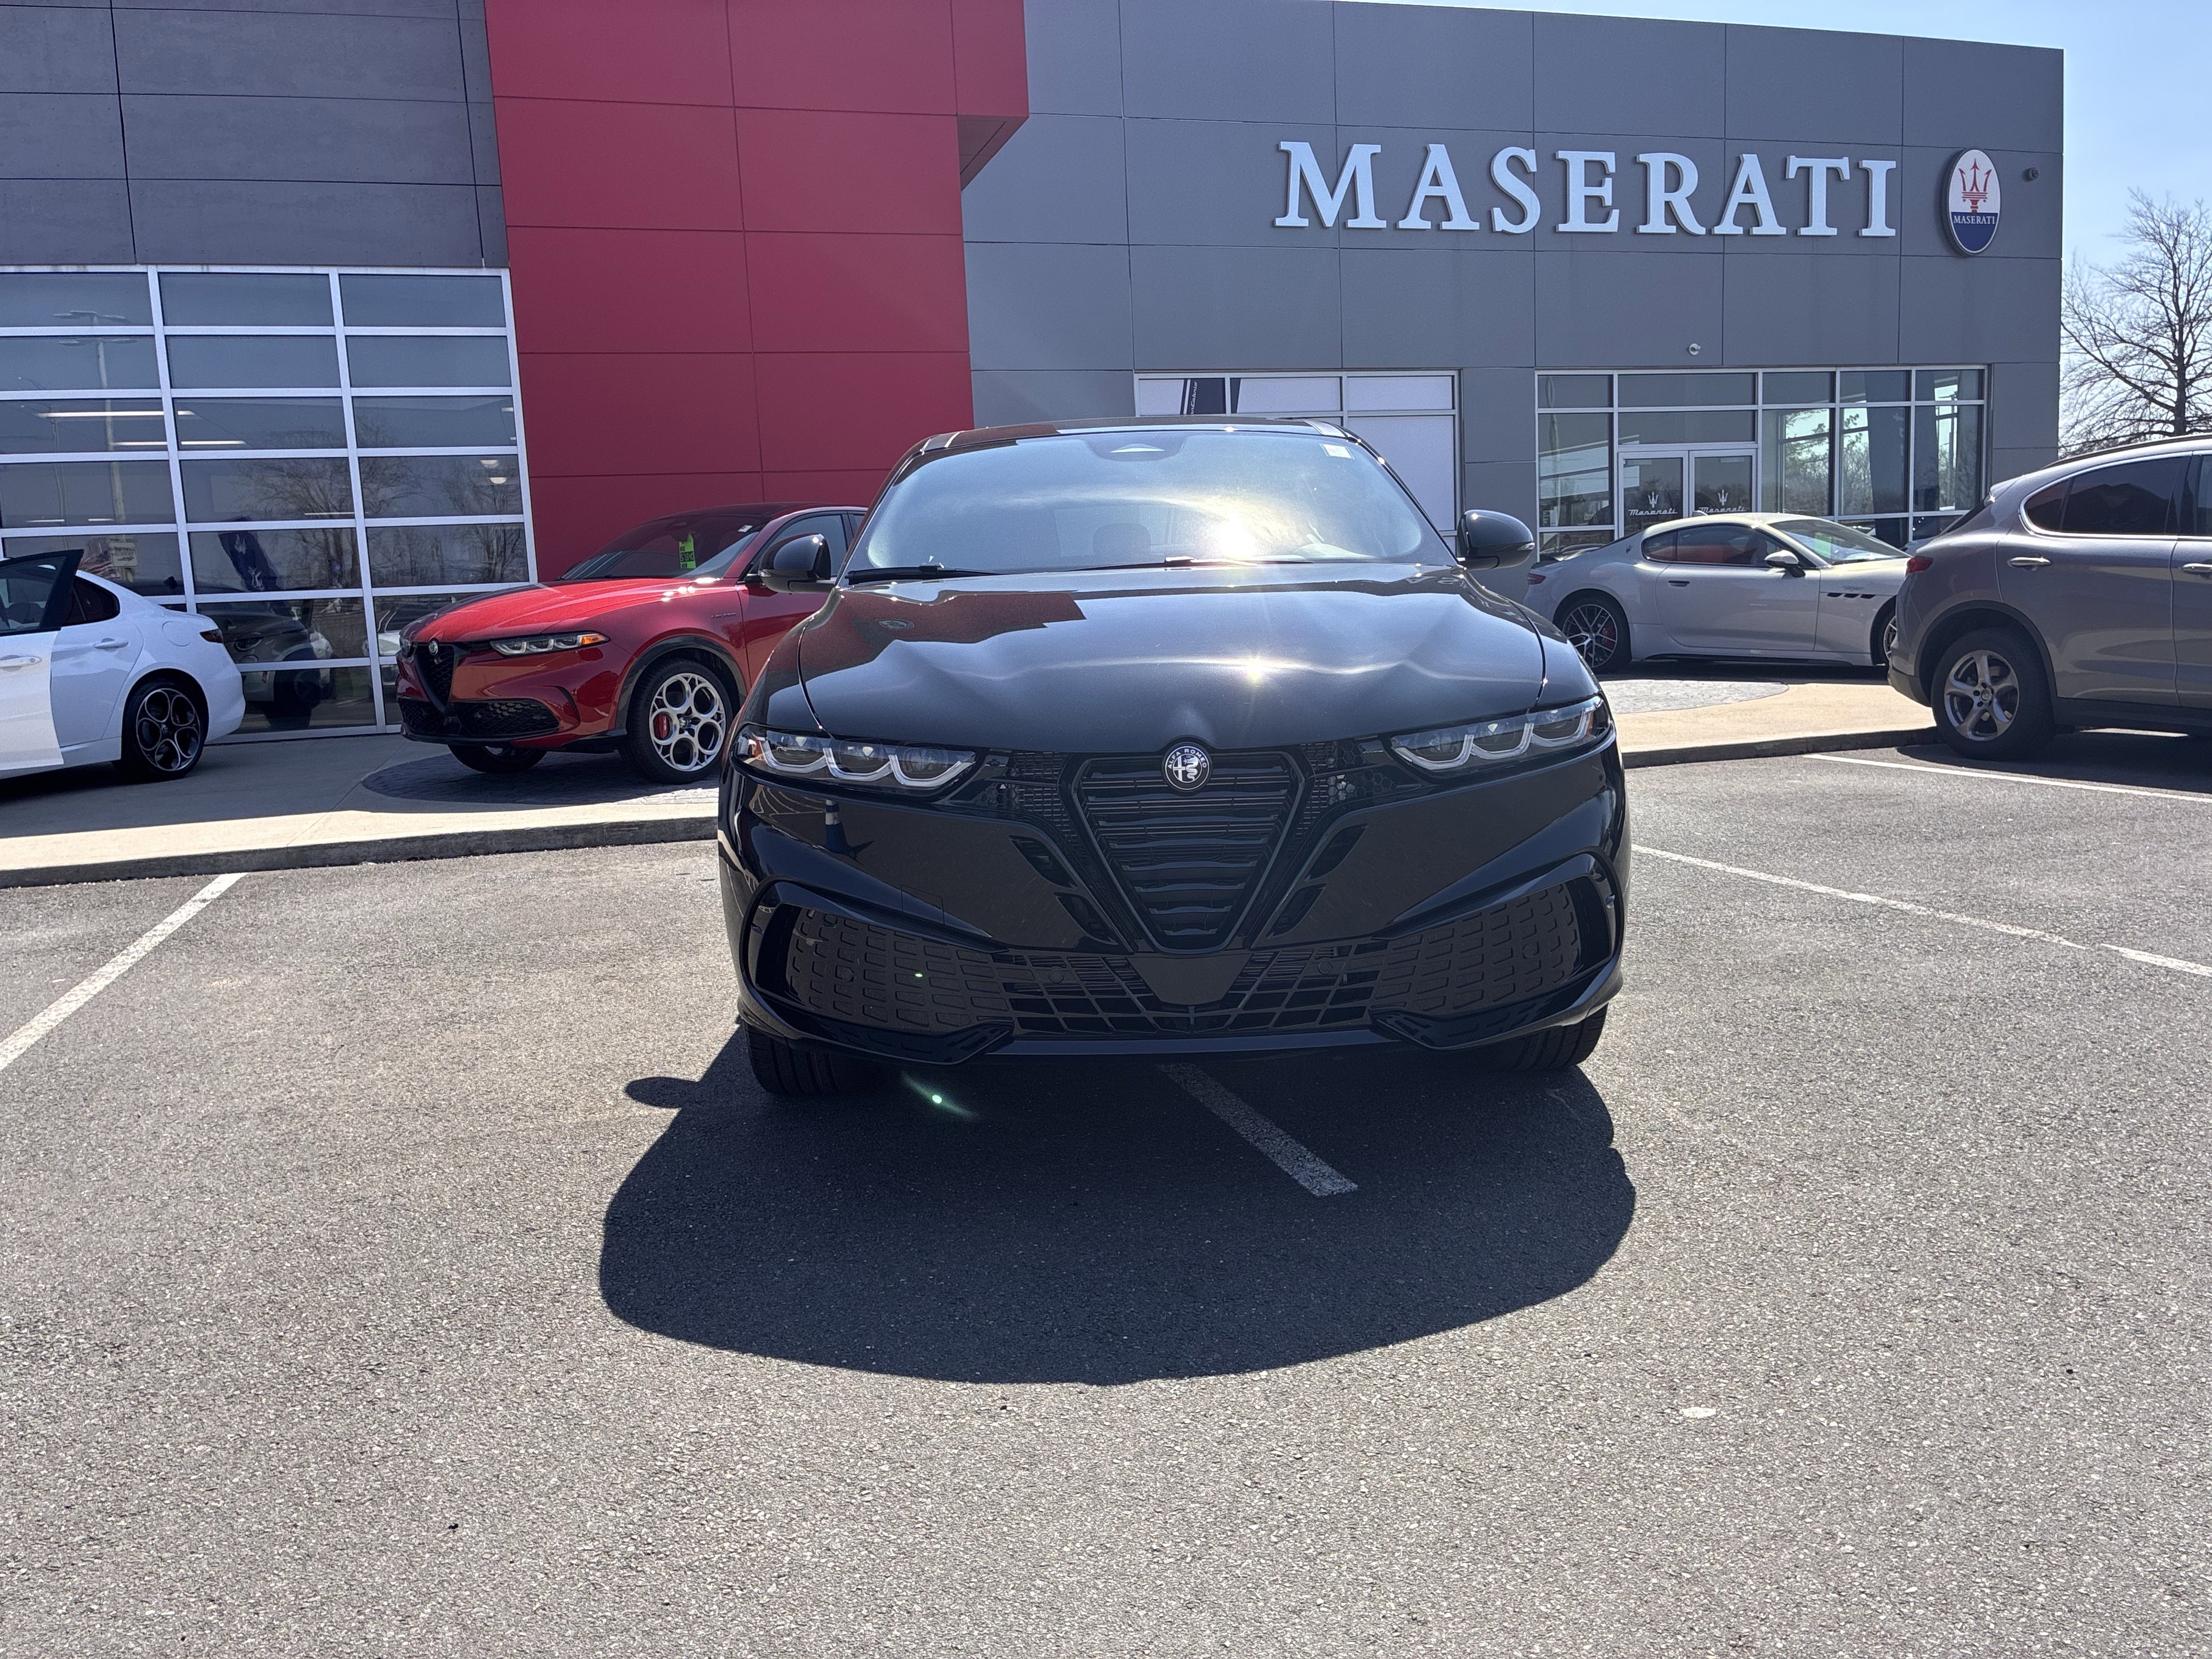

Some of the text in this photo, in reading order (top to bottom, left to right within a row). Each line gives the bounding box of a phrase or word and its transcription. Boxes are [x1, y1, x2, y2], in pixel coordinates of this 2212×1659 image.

[1274, 141, 1897, 236] MASERATI
[1954, 216, 1995, 224] MASERATI
[1167, 748, 1207, 769] ALFA ROMEO
